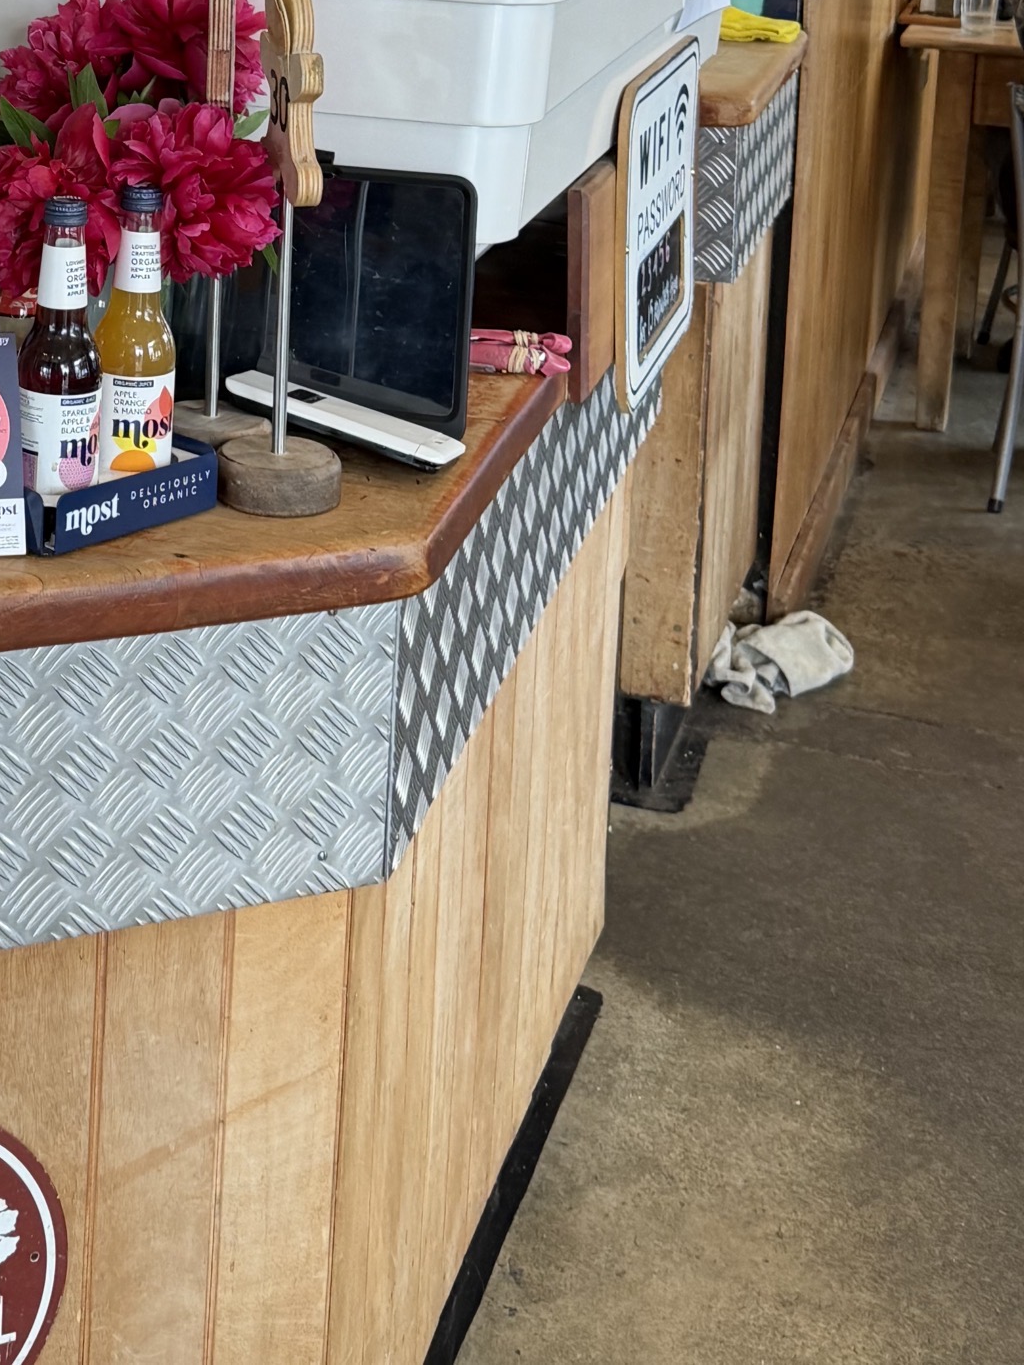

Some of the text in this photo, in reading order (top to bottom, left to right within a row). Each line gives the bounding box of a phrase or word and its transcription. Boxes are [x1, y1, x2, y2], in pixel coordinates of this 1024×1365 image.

[639, 106, 672, 190] WIFI
[637, 164, 686, 252] PASSWORD
[114, 399, 147, 407] ORANGE
[121, 407, 152, 415] MANGO
[61, 418, 85, 426] APPLE
[130, 470, 211, 500] DELICIOUSLY
[143, 486, 198, 509] ORGANIC
[65, 493, 121, 536] most
